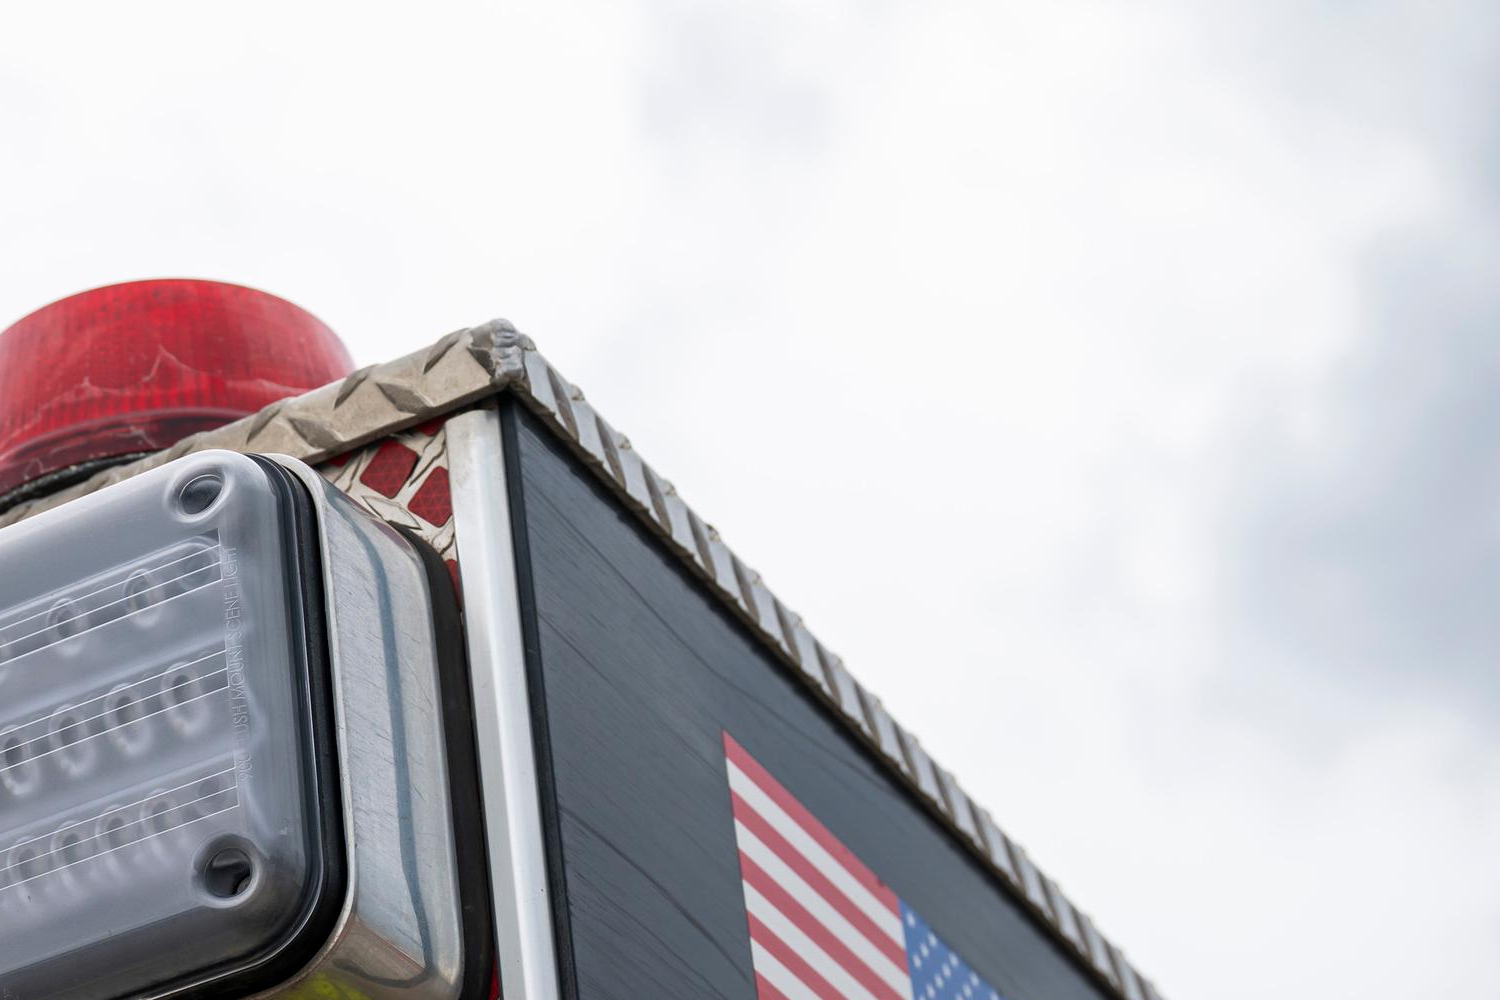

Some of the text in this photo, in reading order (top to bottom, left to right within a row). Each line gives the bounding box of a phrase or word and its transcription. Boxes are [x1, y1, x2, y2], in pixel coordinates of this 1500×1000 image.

[221, 546, 238, 589] LIGHT
[224, 591, 242, 640] SCENE
[227, 643, 246, 700] MOUNT
